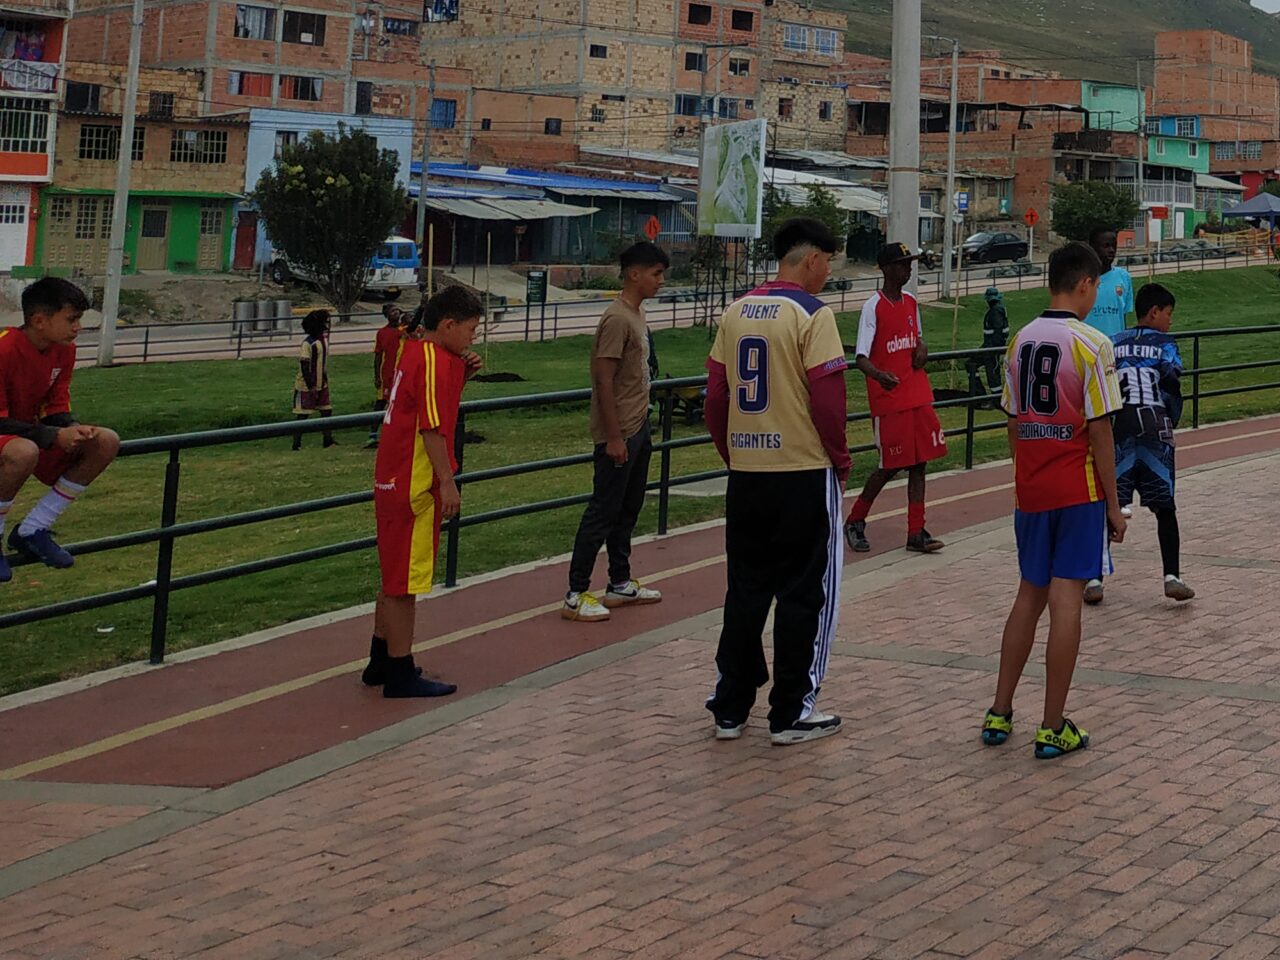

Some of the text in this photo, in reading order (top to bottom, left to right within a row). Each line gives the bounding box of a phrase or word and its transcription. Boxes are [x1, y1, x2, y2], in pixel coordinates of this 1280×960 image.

[740, 303, 781, 320] PUENTE
[736, 334, 769, 415] 9
[1017, 341, 1062, 416] 18
[730, 432, 782, 449] GIGANTES
[1044, 733, 1072, 749] GOLTY
